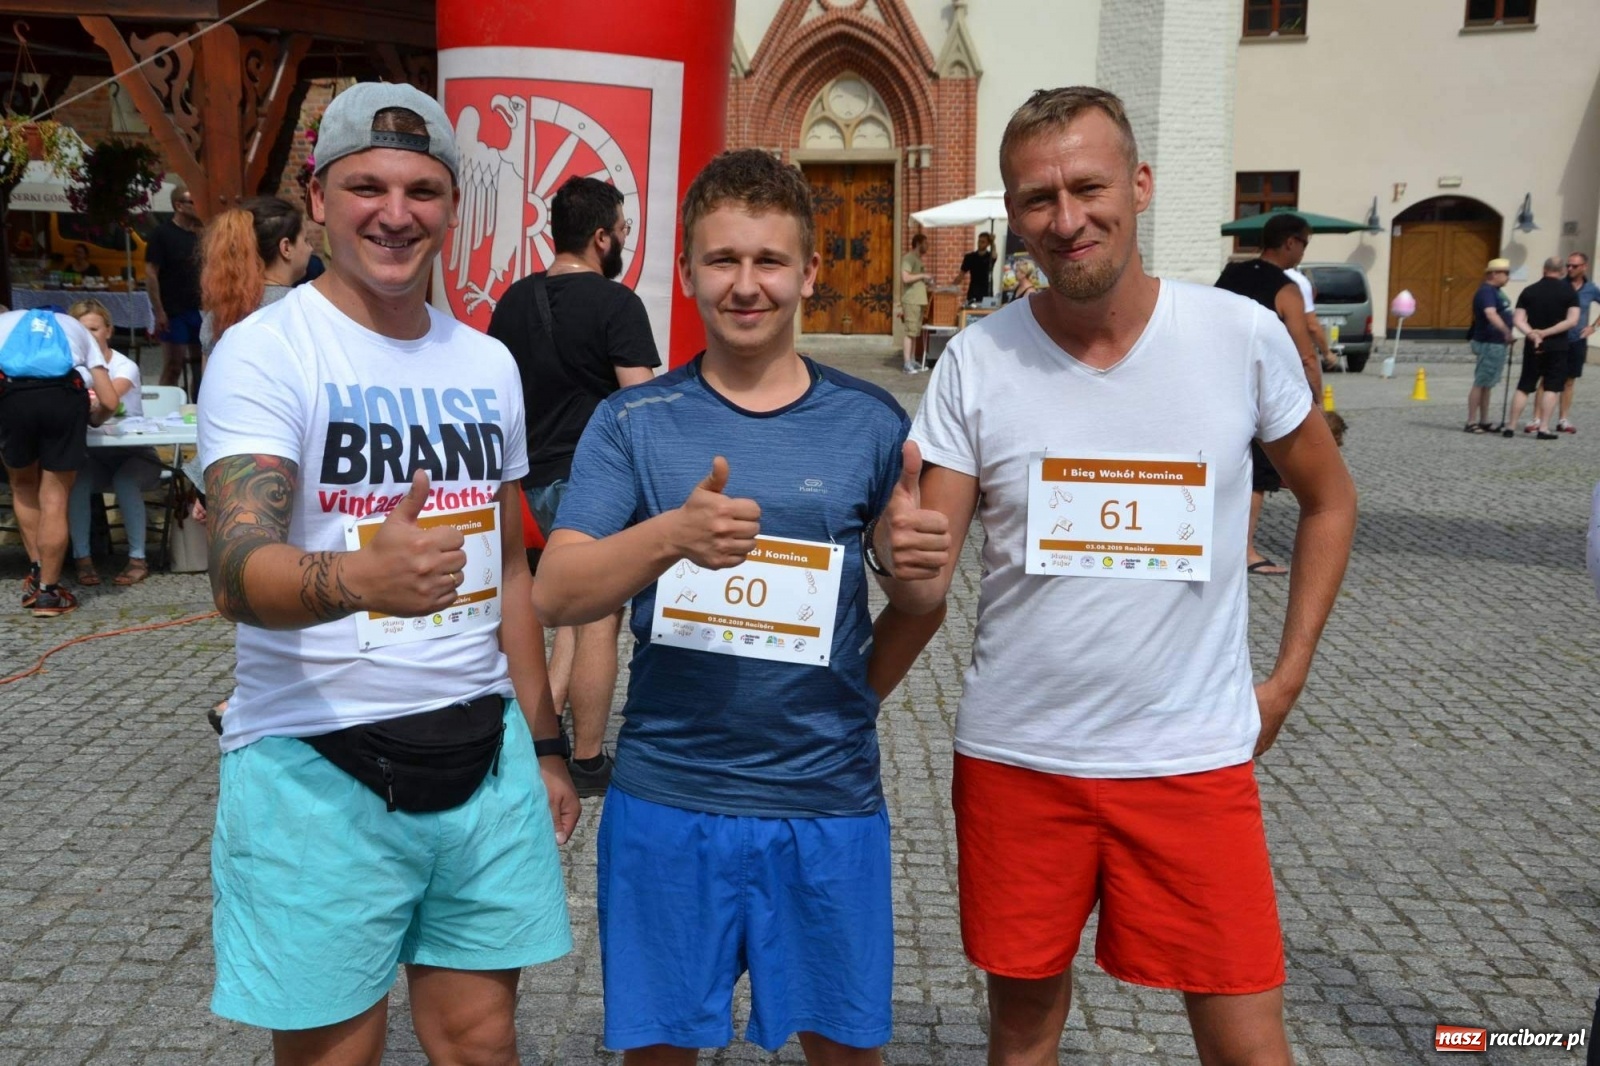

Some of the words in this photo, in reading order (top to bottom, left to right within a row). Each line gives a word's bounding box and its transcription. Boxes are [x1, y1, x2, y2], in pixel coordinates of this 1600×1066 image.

[324, 382, 501, 445] HOUSE
[319, 421, 504, 485] BRAND
[1063, 469, 1066, 477] I
[1071, 468, 1096, 480] Bieg
[1099, 469, 1135, 479] Wokół
[1138, 471, 1184, 481] Komina
[318, 489, 403, 519] Vintag
[421, 485, 493, 512] Clothi
[1100, 500, 1142, 531] 61
[765, 549, 808, 563] Komina
[725, 575, 768, 608] 60
